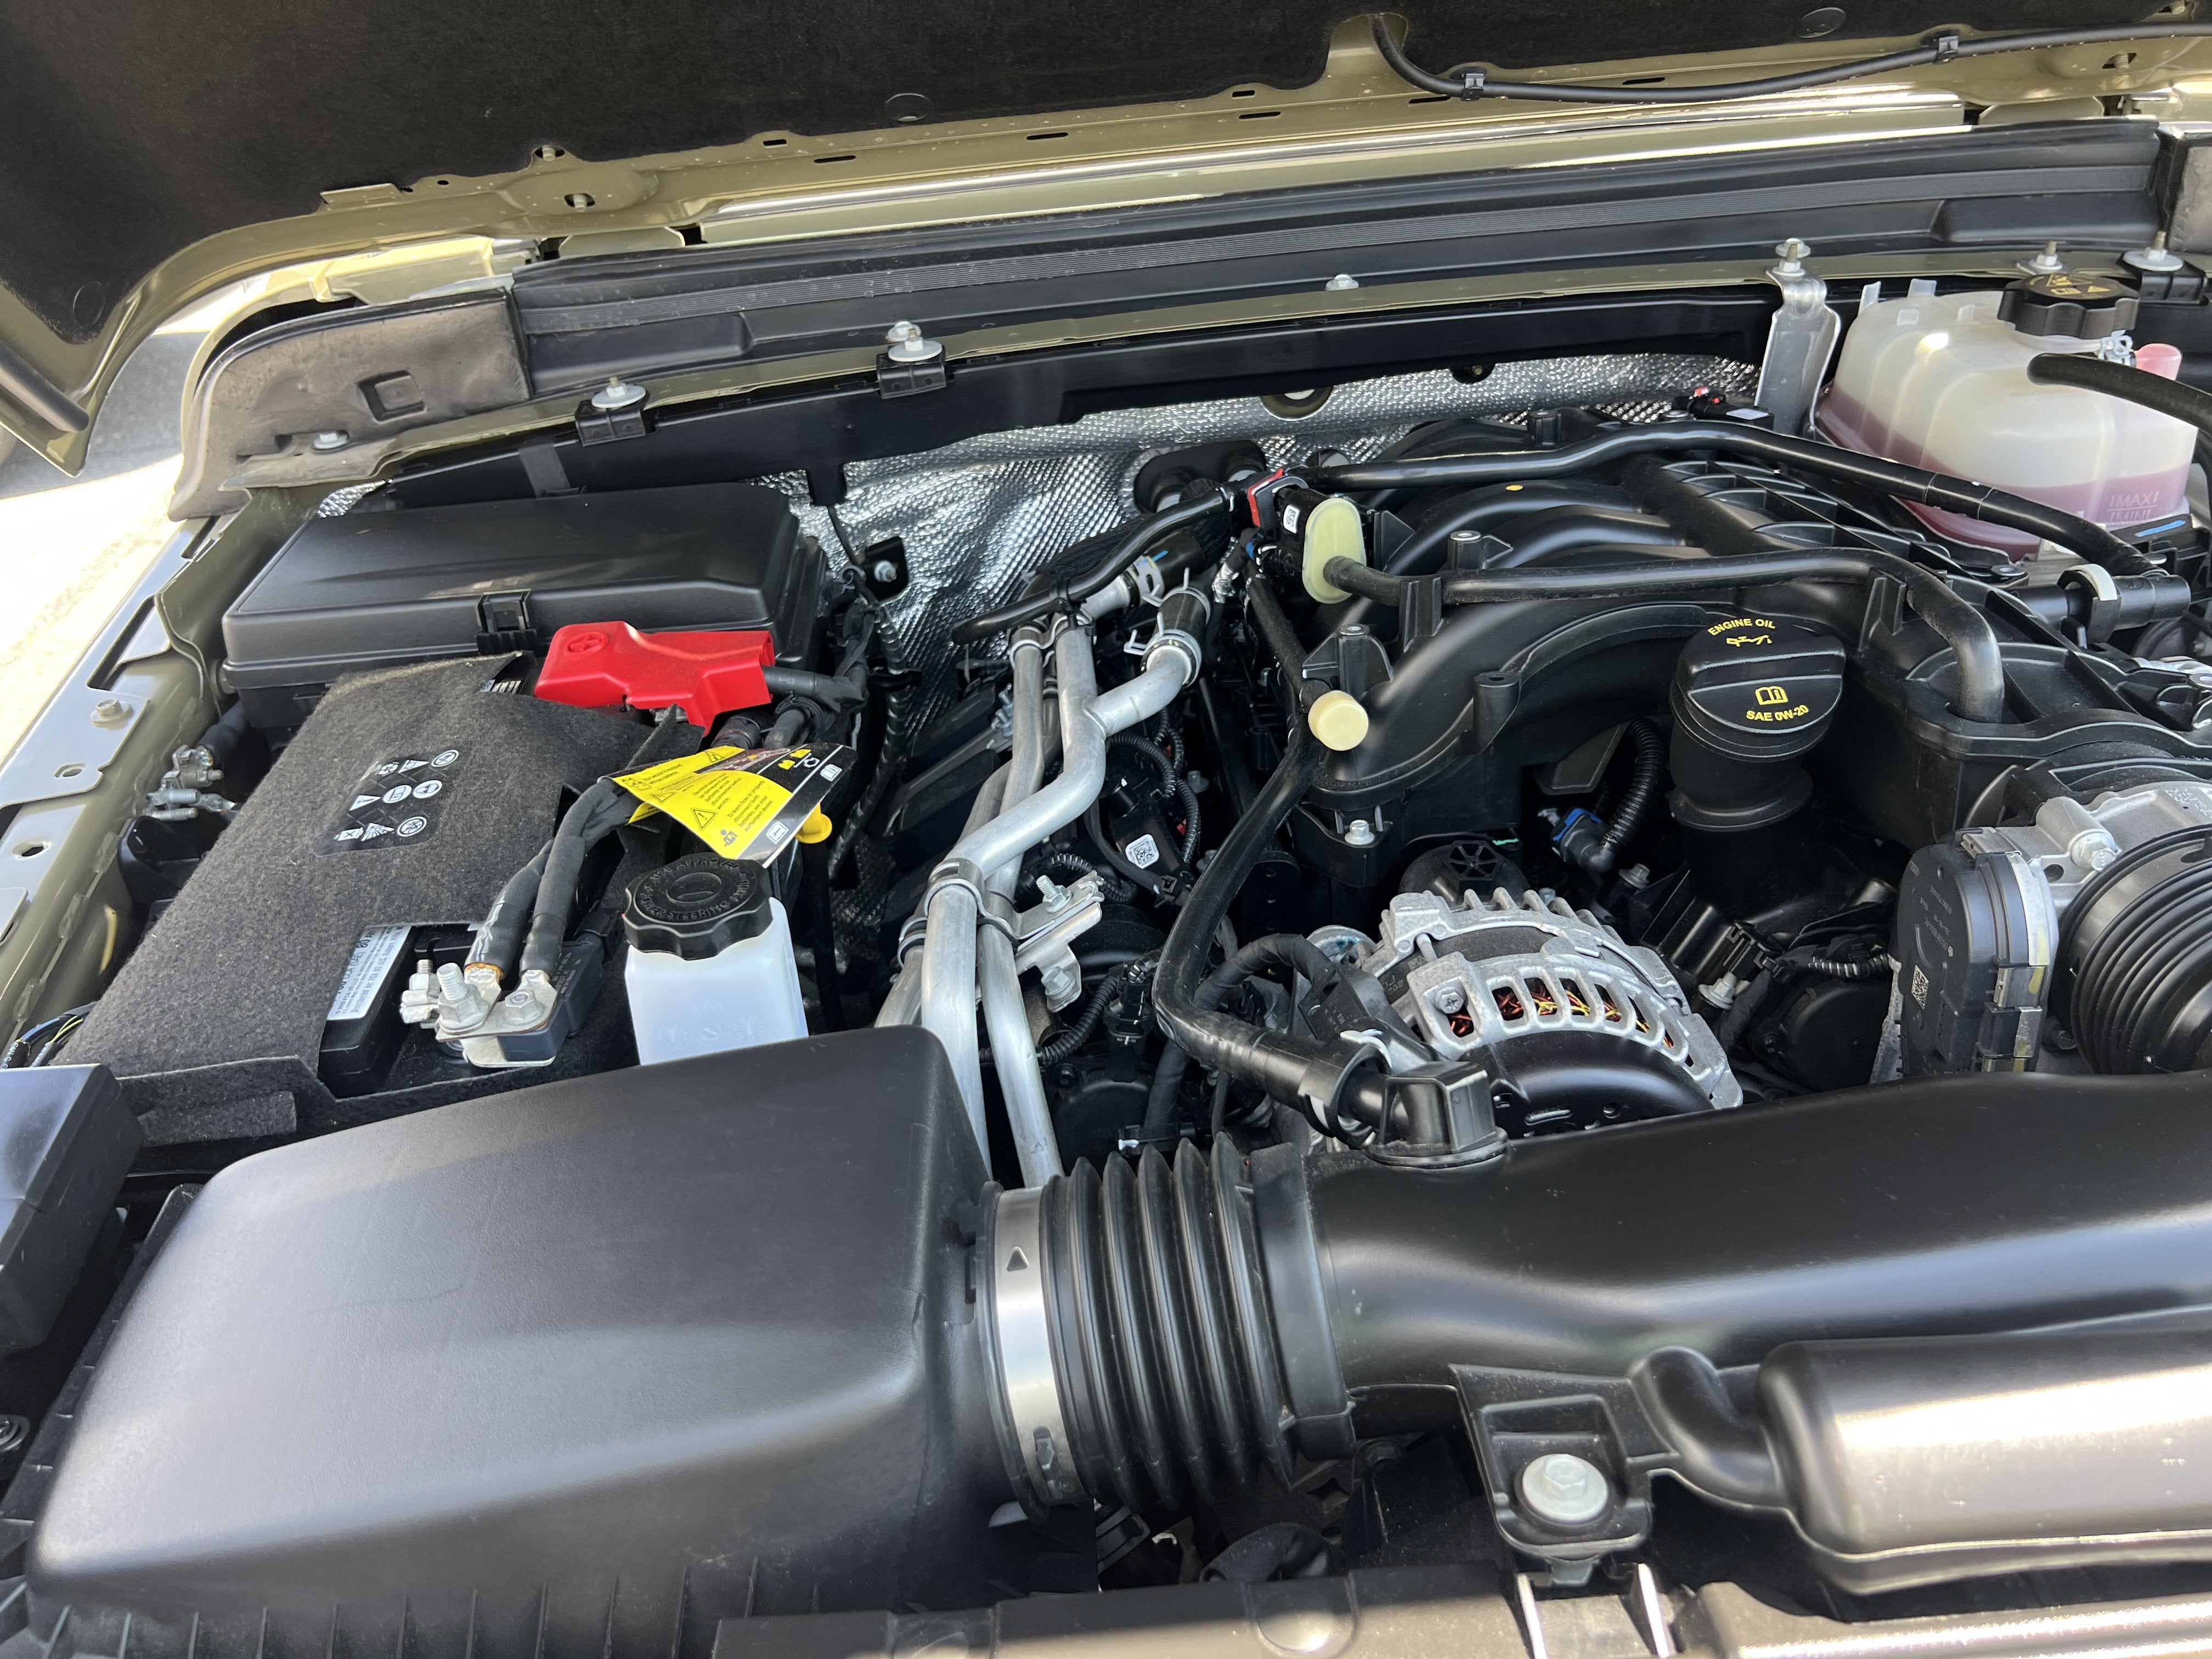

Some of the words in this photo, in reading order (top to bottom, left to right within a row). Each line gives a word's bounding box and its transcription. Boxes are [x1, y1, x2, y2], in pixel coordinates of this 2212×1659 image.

[1707, 618, 1753, 636] ENGINE
[1755, 619, 1776, 629] OIL
[1746, 710, 1773, 722] SAE
[1774, 704, 1810, 721] 0W-20
[732, 803, 742, 814] learn
[740, 795, 749, 805] how
[751, 780, 765, 794] properly
[734, 803, 752, 822] disconnect
[750, 794, 760, 803] both
[667, 900, 731, 920] STEERING
[357, 939, 371, 949] 80
